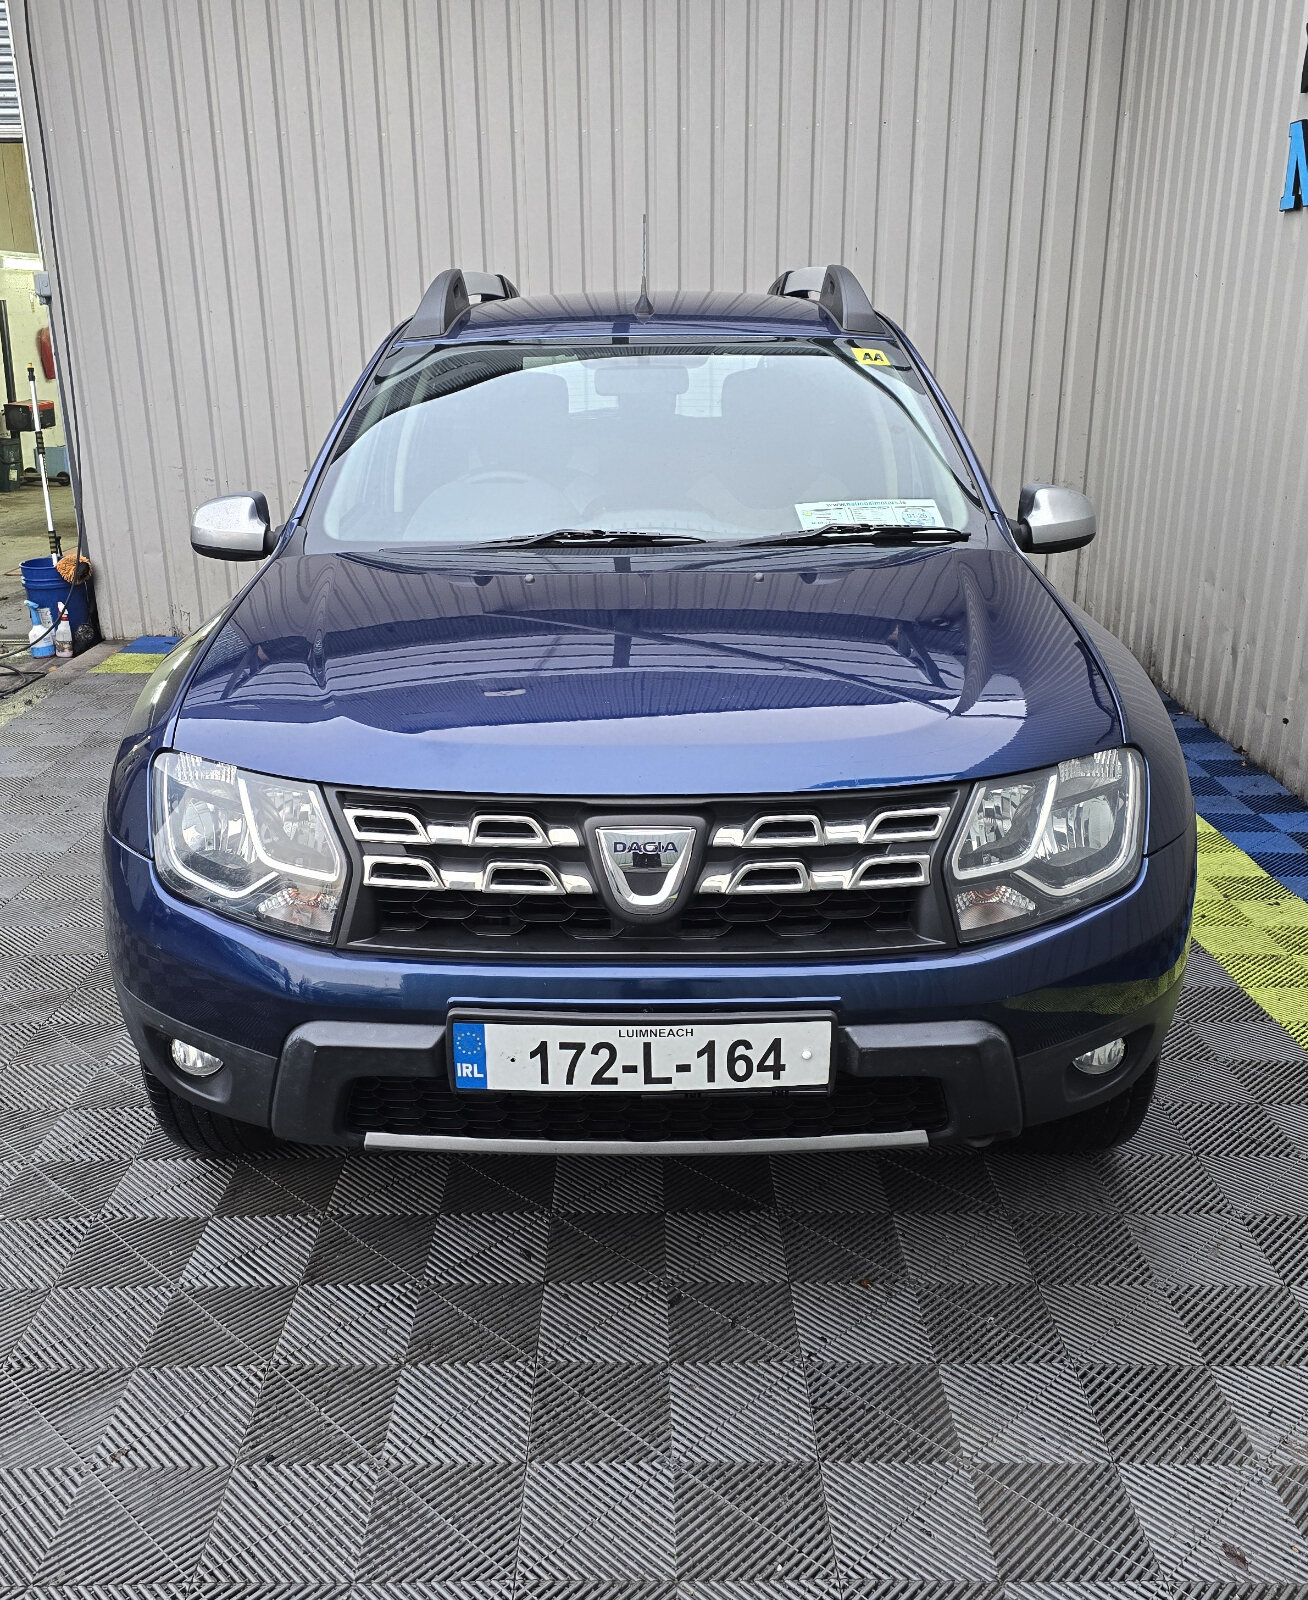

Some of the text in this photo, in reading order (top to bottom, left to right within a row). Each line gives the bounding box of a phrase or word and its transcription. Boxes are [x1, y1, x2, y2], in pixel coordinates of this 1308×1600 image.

[863, 352, 884, 362] AA
[613, 841, 679, 854] DACIA
[618, 1027, 695, 1039] LUIMNEACH
[528, 1037, 787, 1086] 172-L-164
[456, 1062, 484, 1079] IRL
